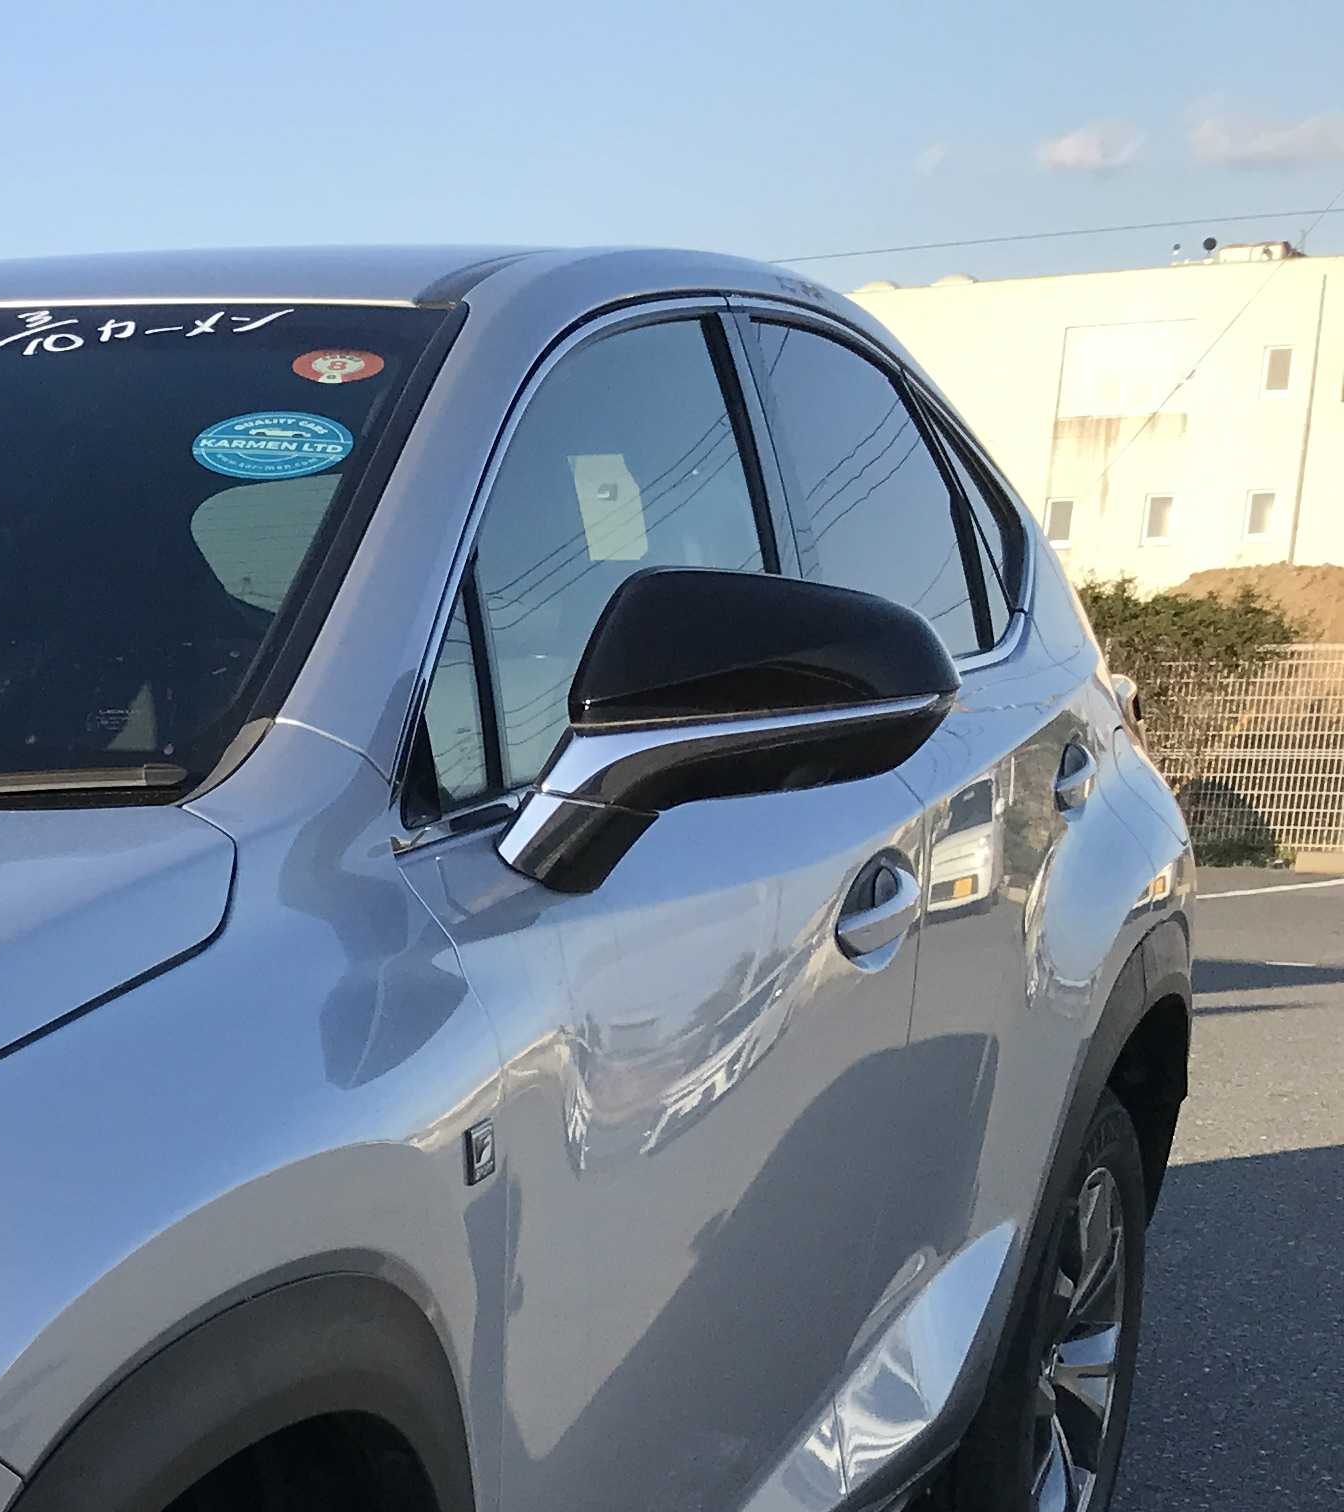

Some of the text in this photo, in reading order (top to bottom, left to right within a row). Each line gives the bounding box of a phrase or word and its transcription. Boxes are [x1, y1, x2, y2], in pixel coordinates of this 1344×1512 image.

[233, 417, 297, 431] QUALITY
[199, 438, 344, 453] KARMEN LTD
